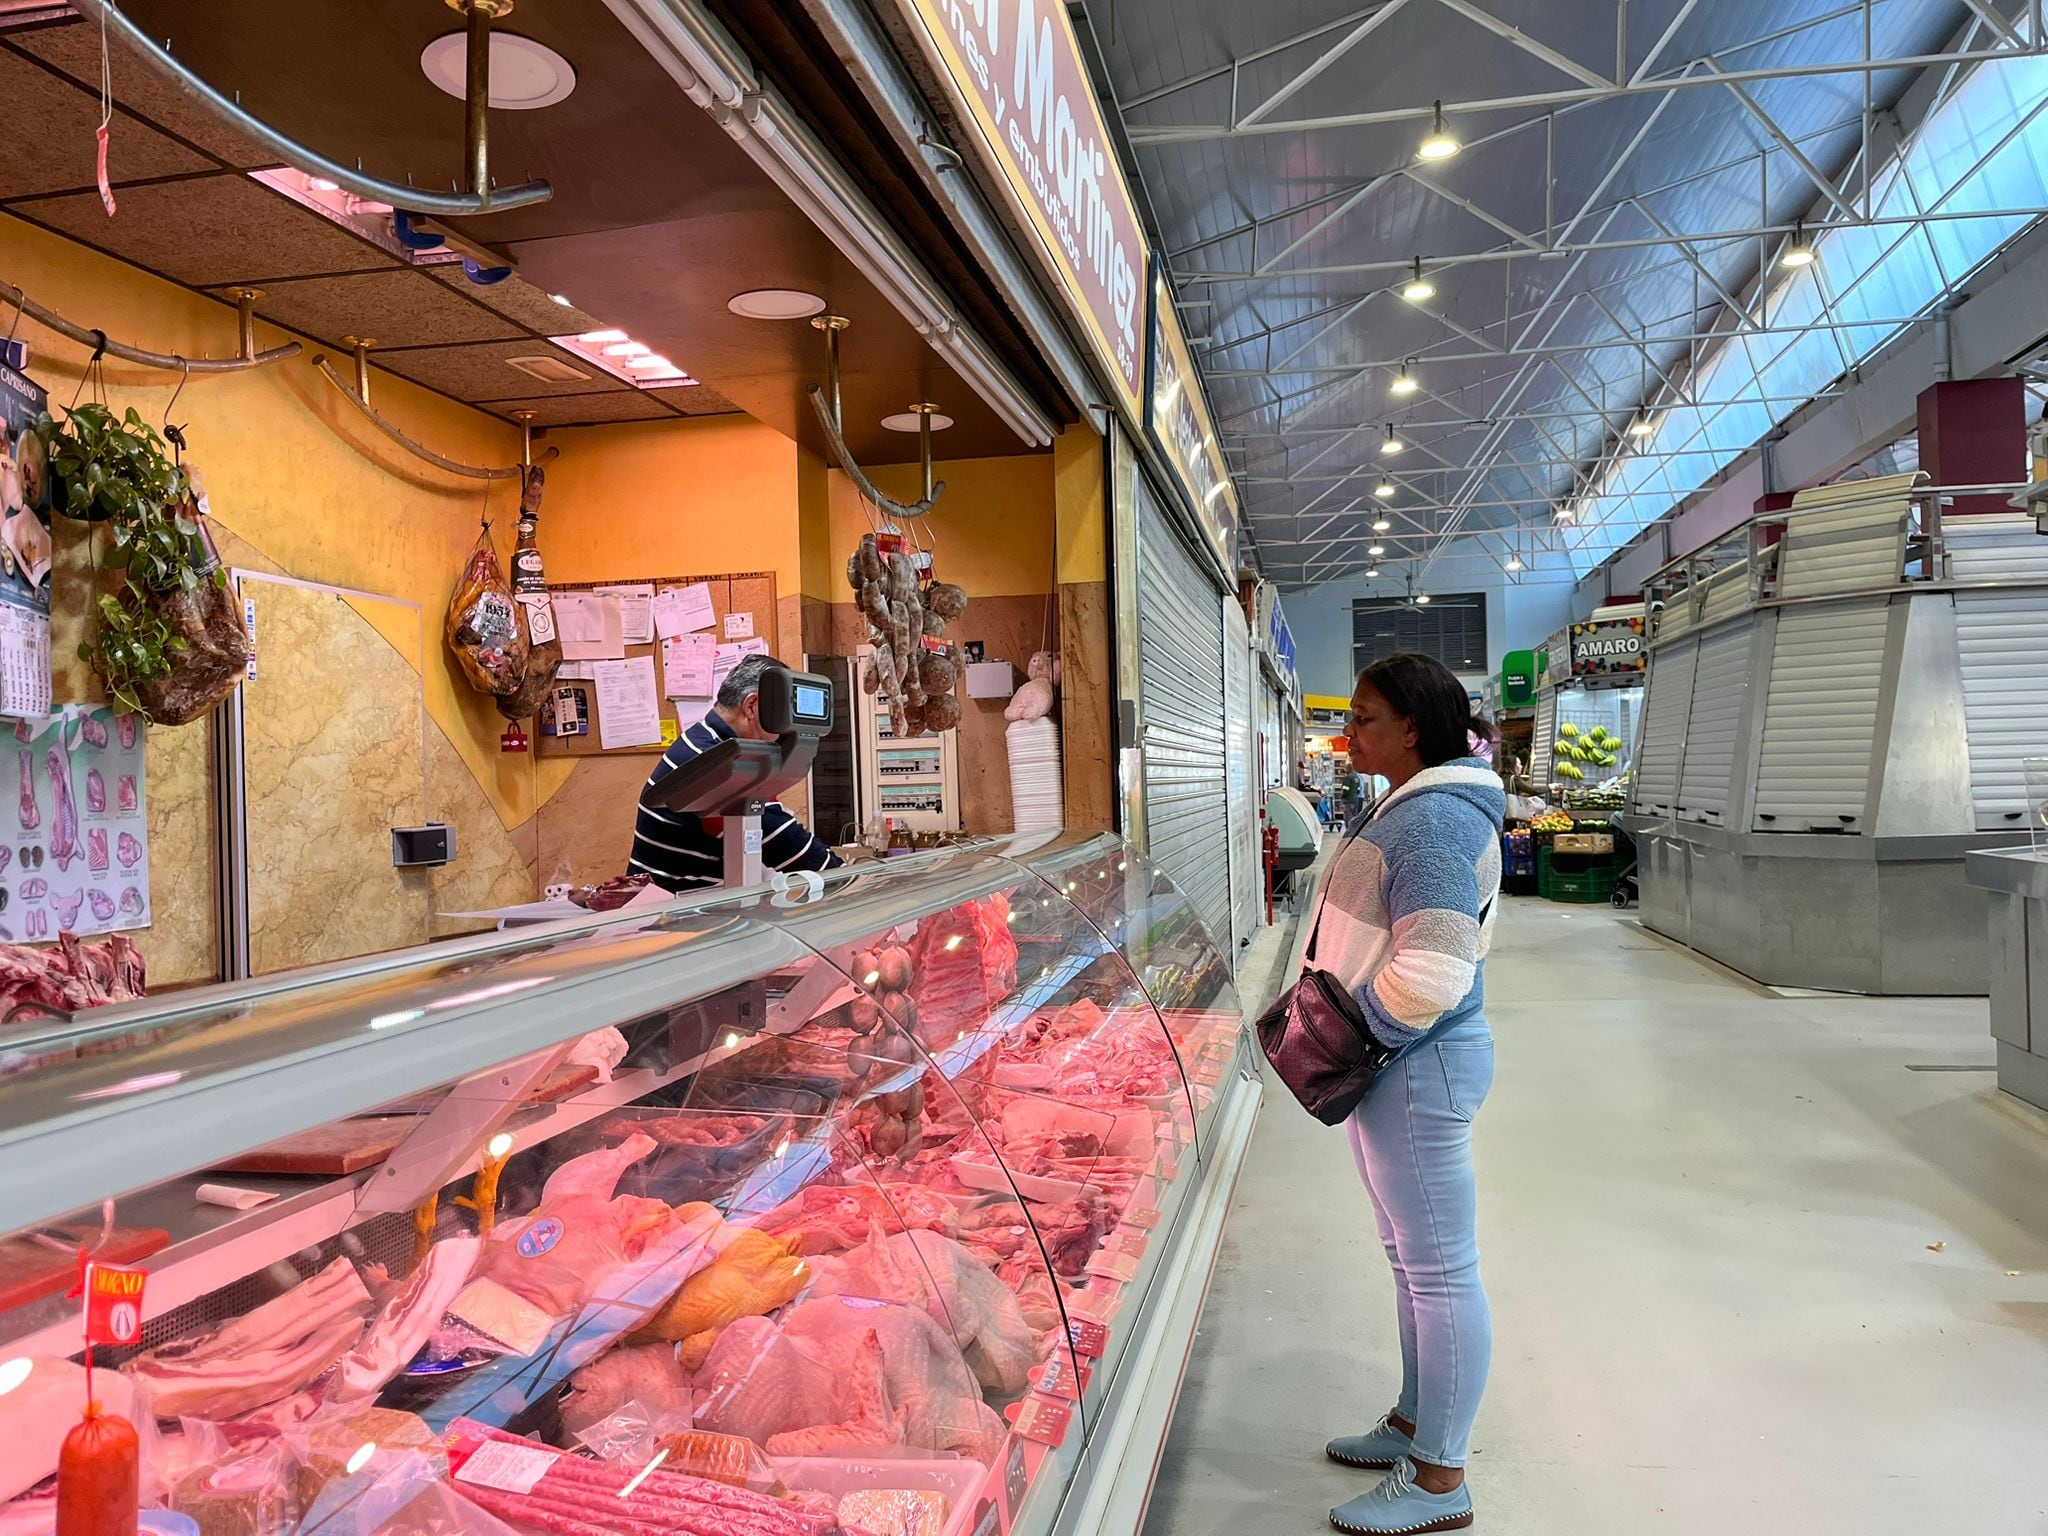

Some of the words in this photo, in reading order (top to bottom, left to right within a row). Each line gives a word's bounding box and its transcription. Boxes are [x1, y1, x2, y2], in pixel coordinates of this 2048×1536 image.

[942, 0, 989, 91] nes
[993, 82, 1006, 126] y
[1008, 118, 1081, 272] embutidos
[1577, 638, 1639, 657] AMARO
